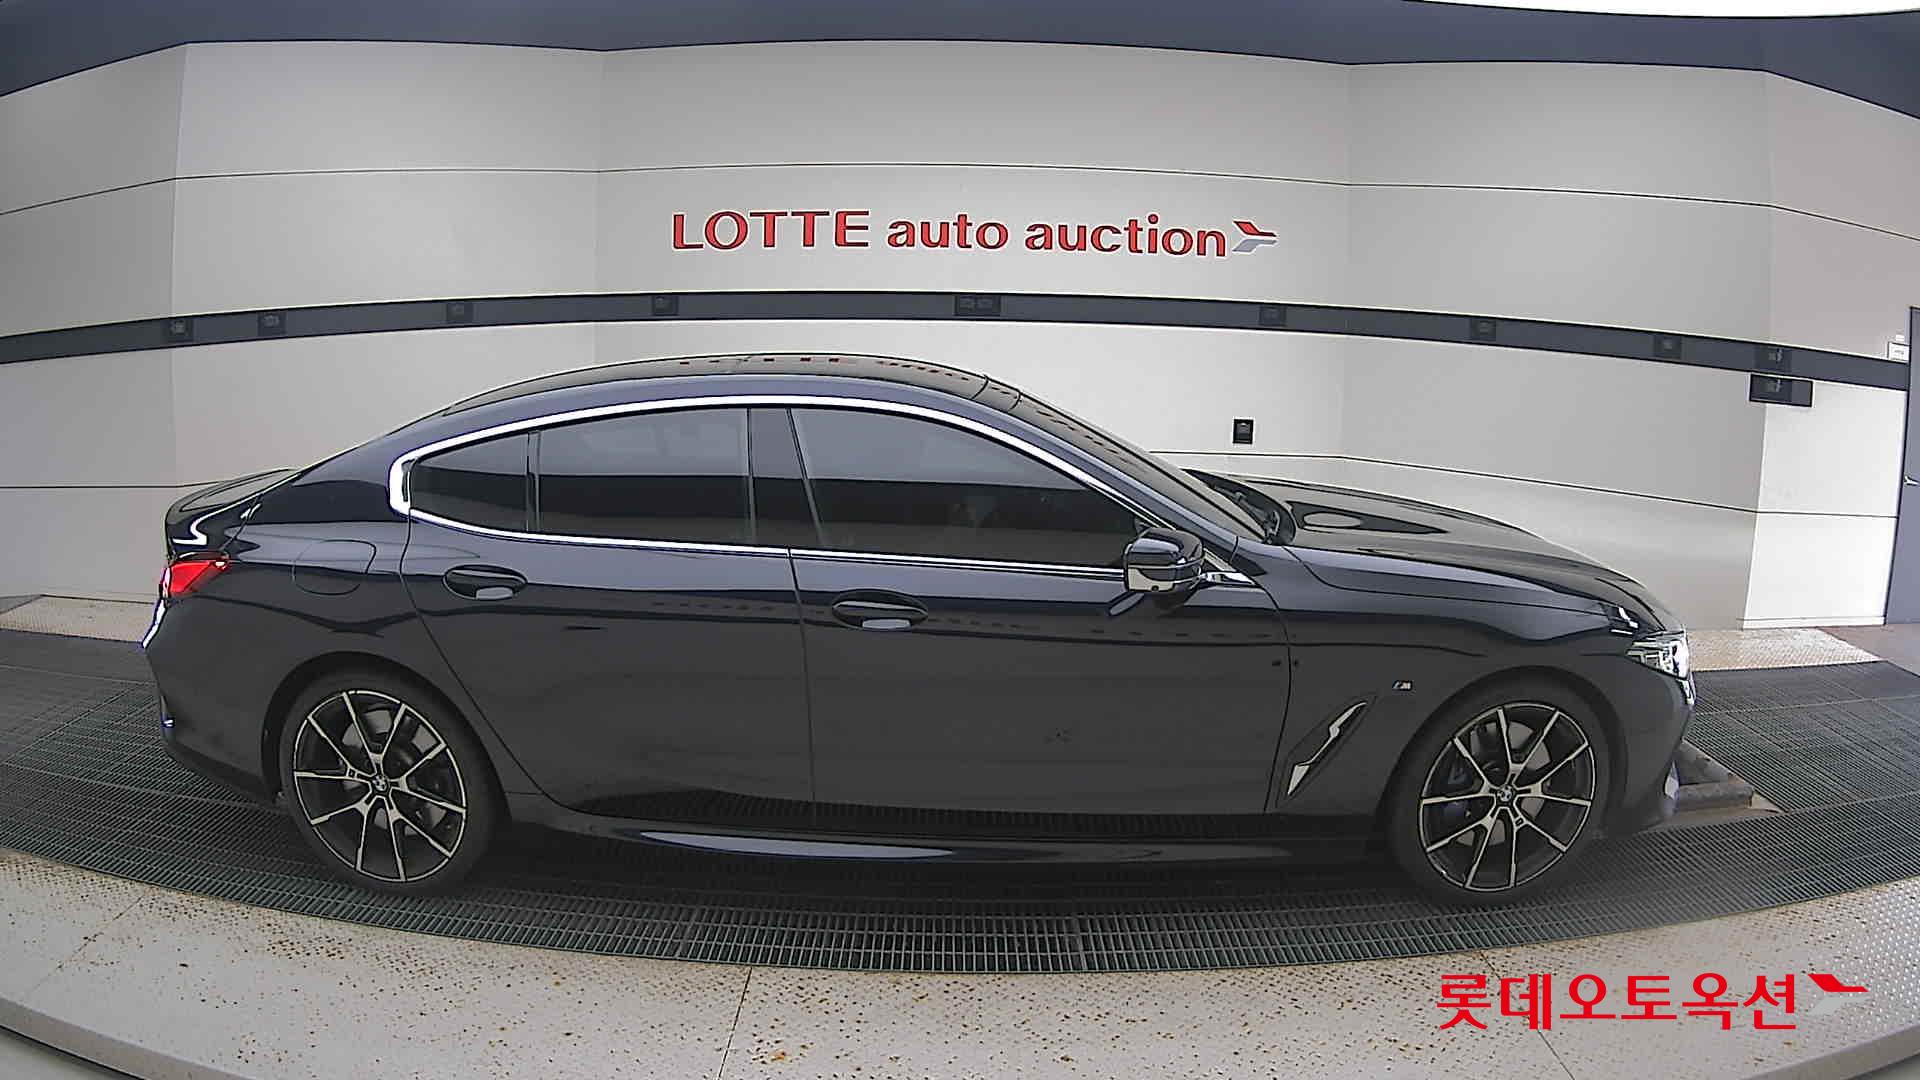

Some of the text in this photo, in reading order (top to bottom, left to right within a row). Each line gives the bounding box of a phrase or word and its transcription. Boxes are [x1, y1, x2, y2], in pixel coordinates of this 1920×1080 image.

[672, 210, 1227, 257] LOTTE auto auction
